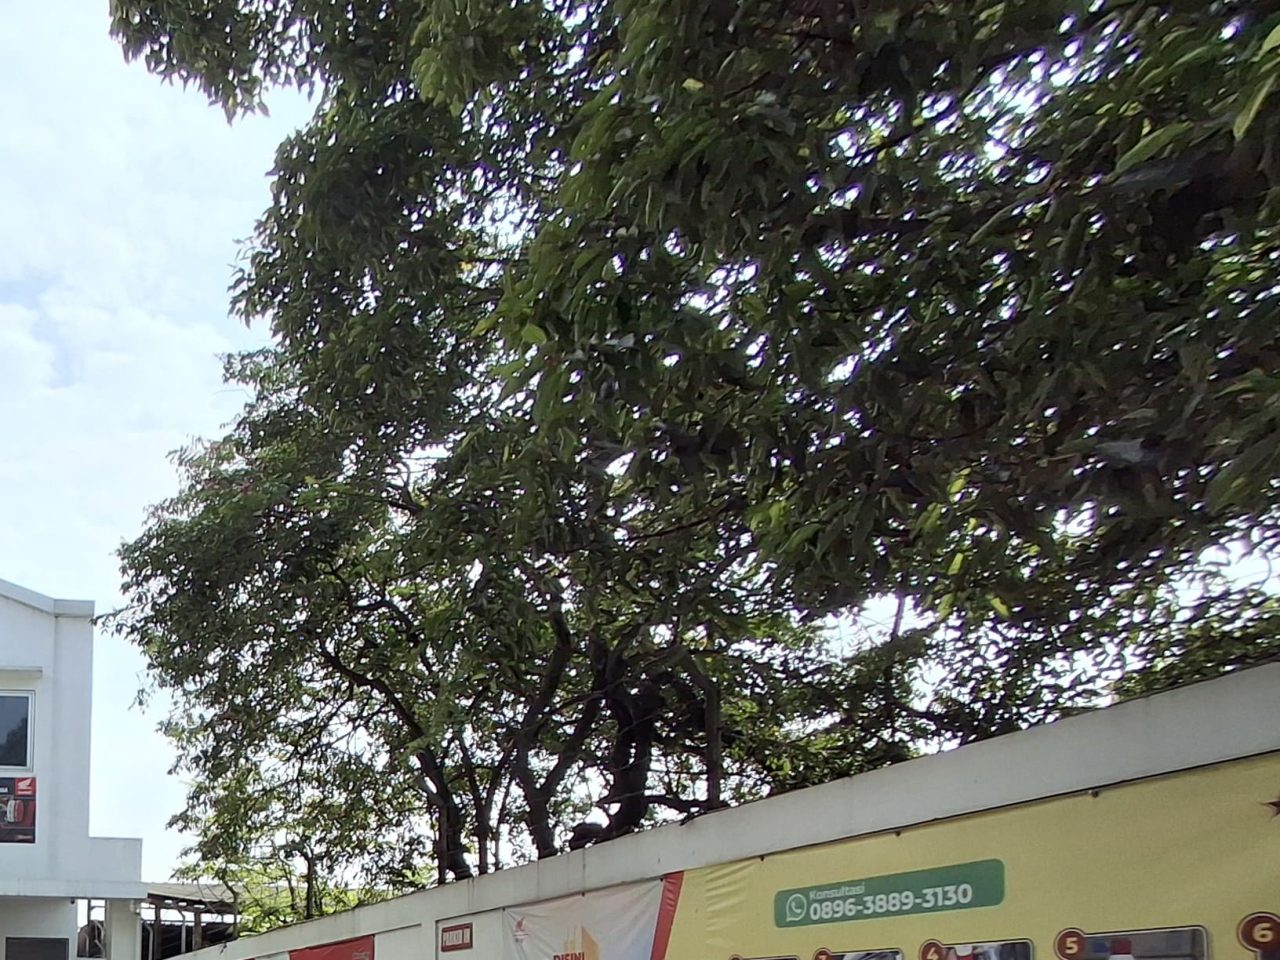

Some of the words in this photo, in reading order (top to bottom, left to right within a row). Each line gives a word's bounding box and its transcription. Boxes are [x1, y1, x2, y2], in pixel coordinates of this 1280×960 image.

[809, 881, 865, 900] Konsultasi
[809, 884, 973, 921] 0896-3889-3130
[1252, 922, 1274, 942] 6
[1065, 937, 1078, 954] 5
